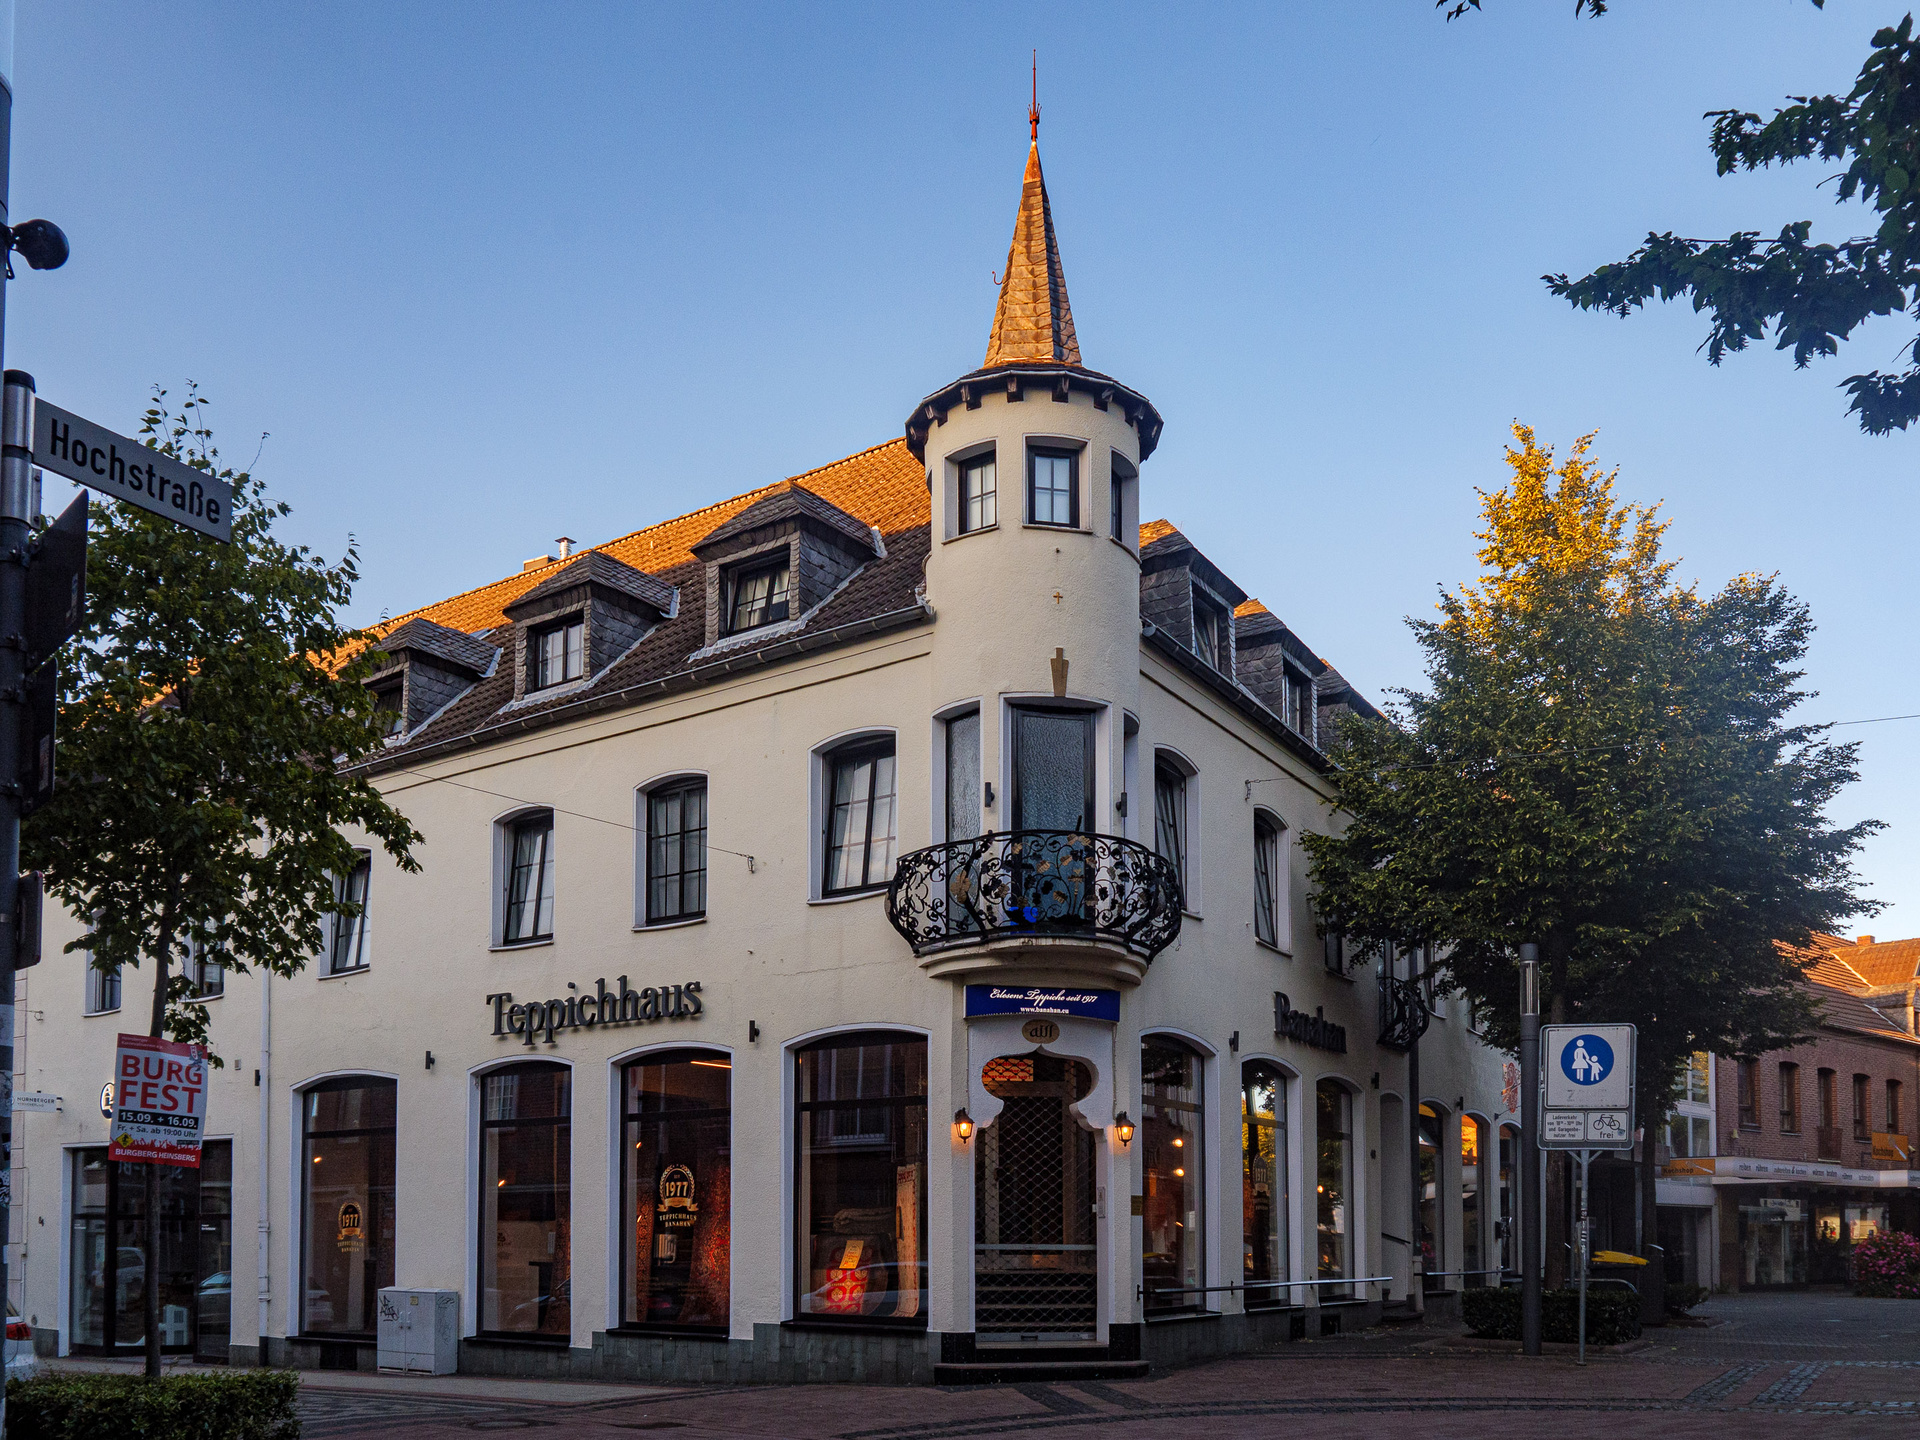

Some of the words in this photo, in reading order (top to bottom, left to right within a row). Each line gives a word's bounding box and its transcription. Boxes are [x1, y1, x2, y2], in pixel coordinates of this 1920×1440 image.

[50, 418, 221, 524] Hochstraße
[990, 988, 1023, 1000] Erlesene
[1024, 989, 1065, 1006] Teppiche
[1066, 994, 1081, 1002] seit
[1081, 996, 1098, 1004] 1977
[486, 974, 703, 1046] Teppichhaus
[121, 1054, 202, 1086] BURG
[118, 1079, 202, 1114] FEST
[120, 1112, 154, 1123] 15.09.
[168, 1116, 197, 1128] 16.09.
[163, 1128, 182, 1136] 19:00
[184, 1130, 197, 1138] Uhr
[115, 1148, 158, 1158] BURGBERG
[158, 1152, 196, 1162] HEINSBERG
[665, 1182, 688, 1197] 1977
[342, 1214, 359, 1227] 1977
[659, 1213, 697, 1221] TEPPICHHAUS
